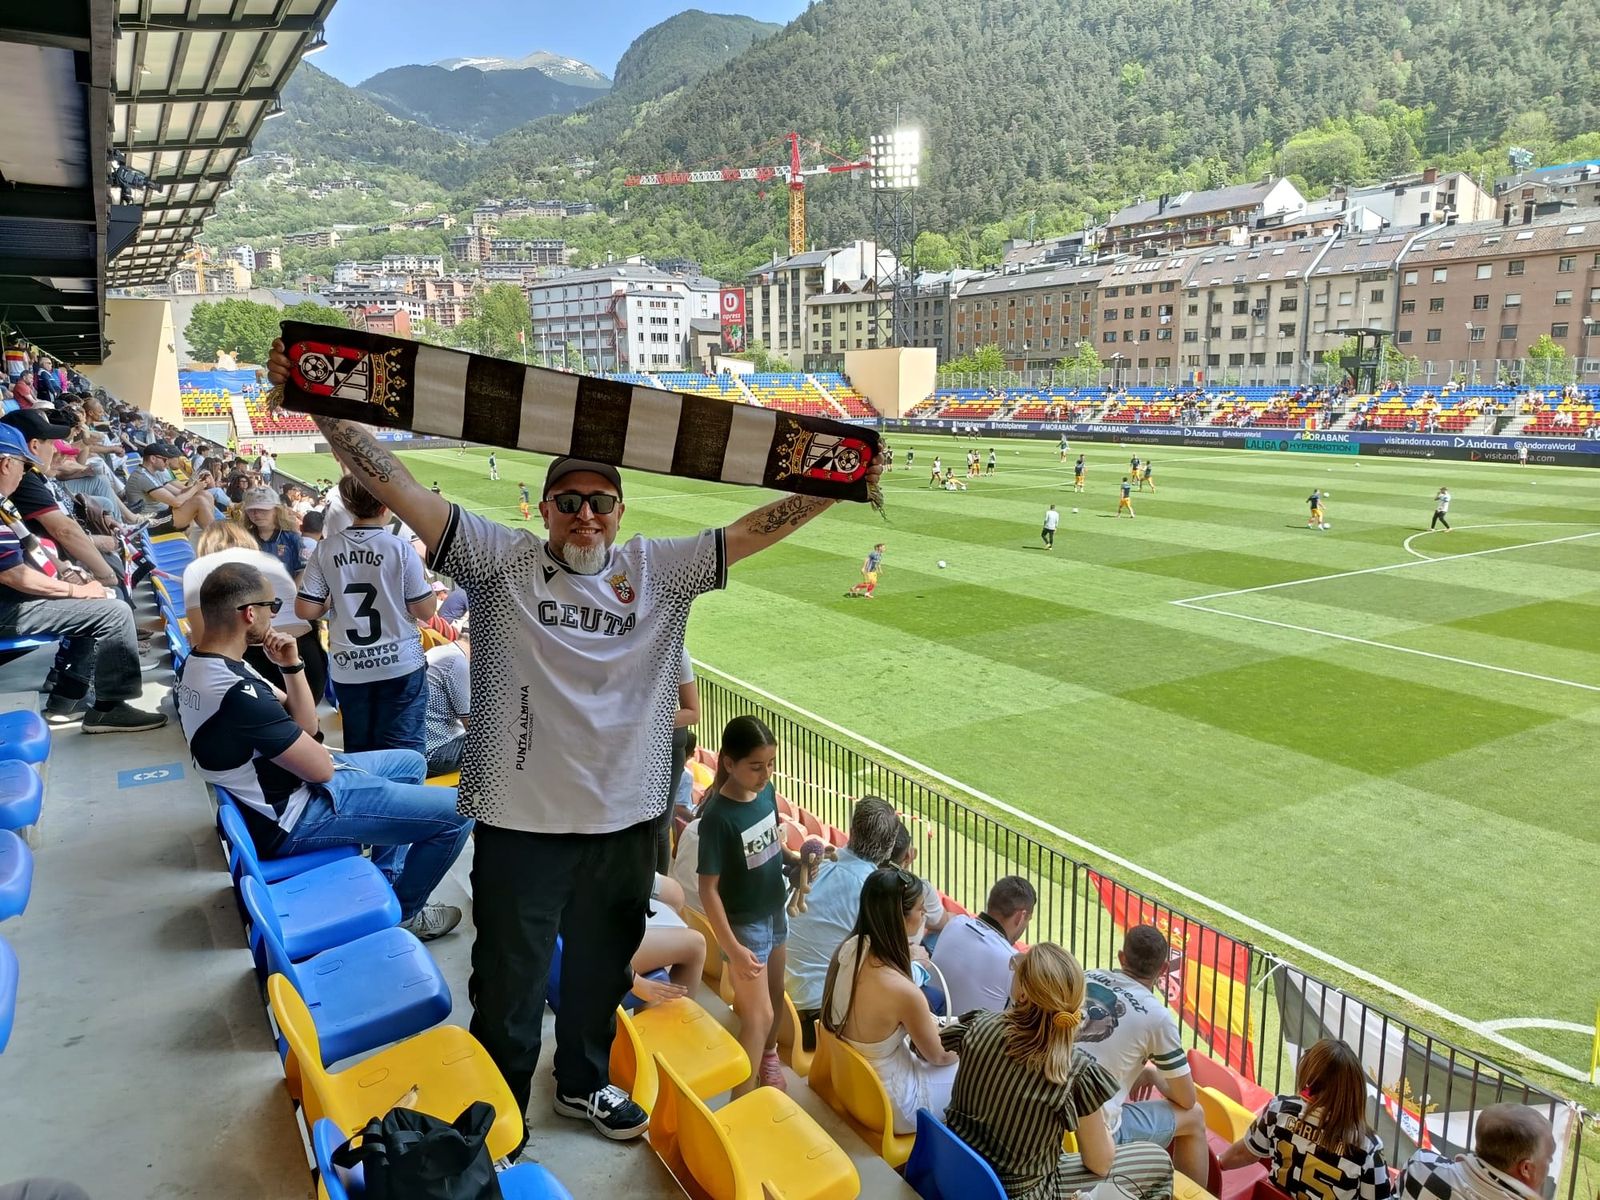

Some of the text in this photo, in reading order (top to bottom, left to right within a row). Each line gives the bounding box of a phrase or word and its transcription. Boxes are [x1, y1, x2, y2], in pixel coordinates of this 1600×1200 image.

[996, 422, 1028, 430] hotelplanner
[1191, 429, 1219, 437] Andorra
[1246, 440, 1352, 452] LALIGA HYPERMOTION
[1384, 437, 1449, 446] visitandorra.com
[1466, 439, 1508, 449] Andorra
[333, 550, 384, 568] MATOS
[343, 582, 382, 646] 3
[538, 600, 636, 637] CEUTA
[350, 643, 399, 660] DARYSO
[354, 654, 400, 671] MOTOR
[516, 685, 530, 771] PUNTA ALMINA
[1276, 1140, 1343, 1200] 15
